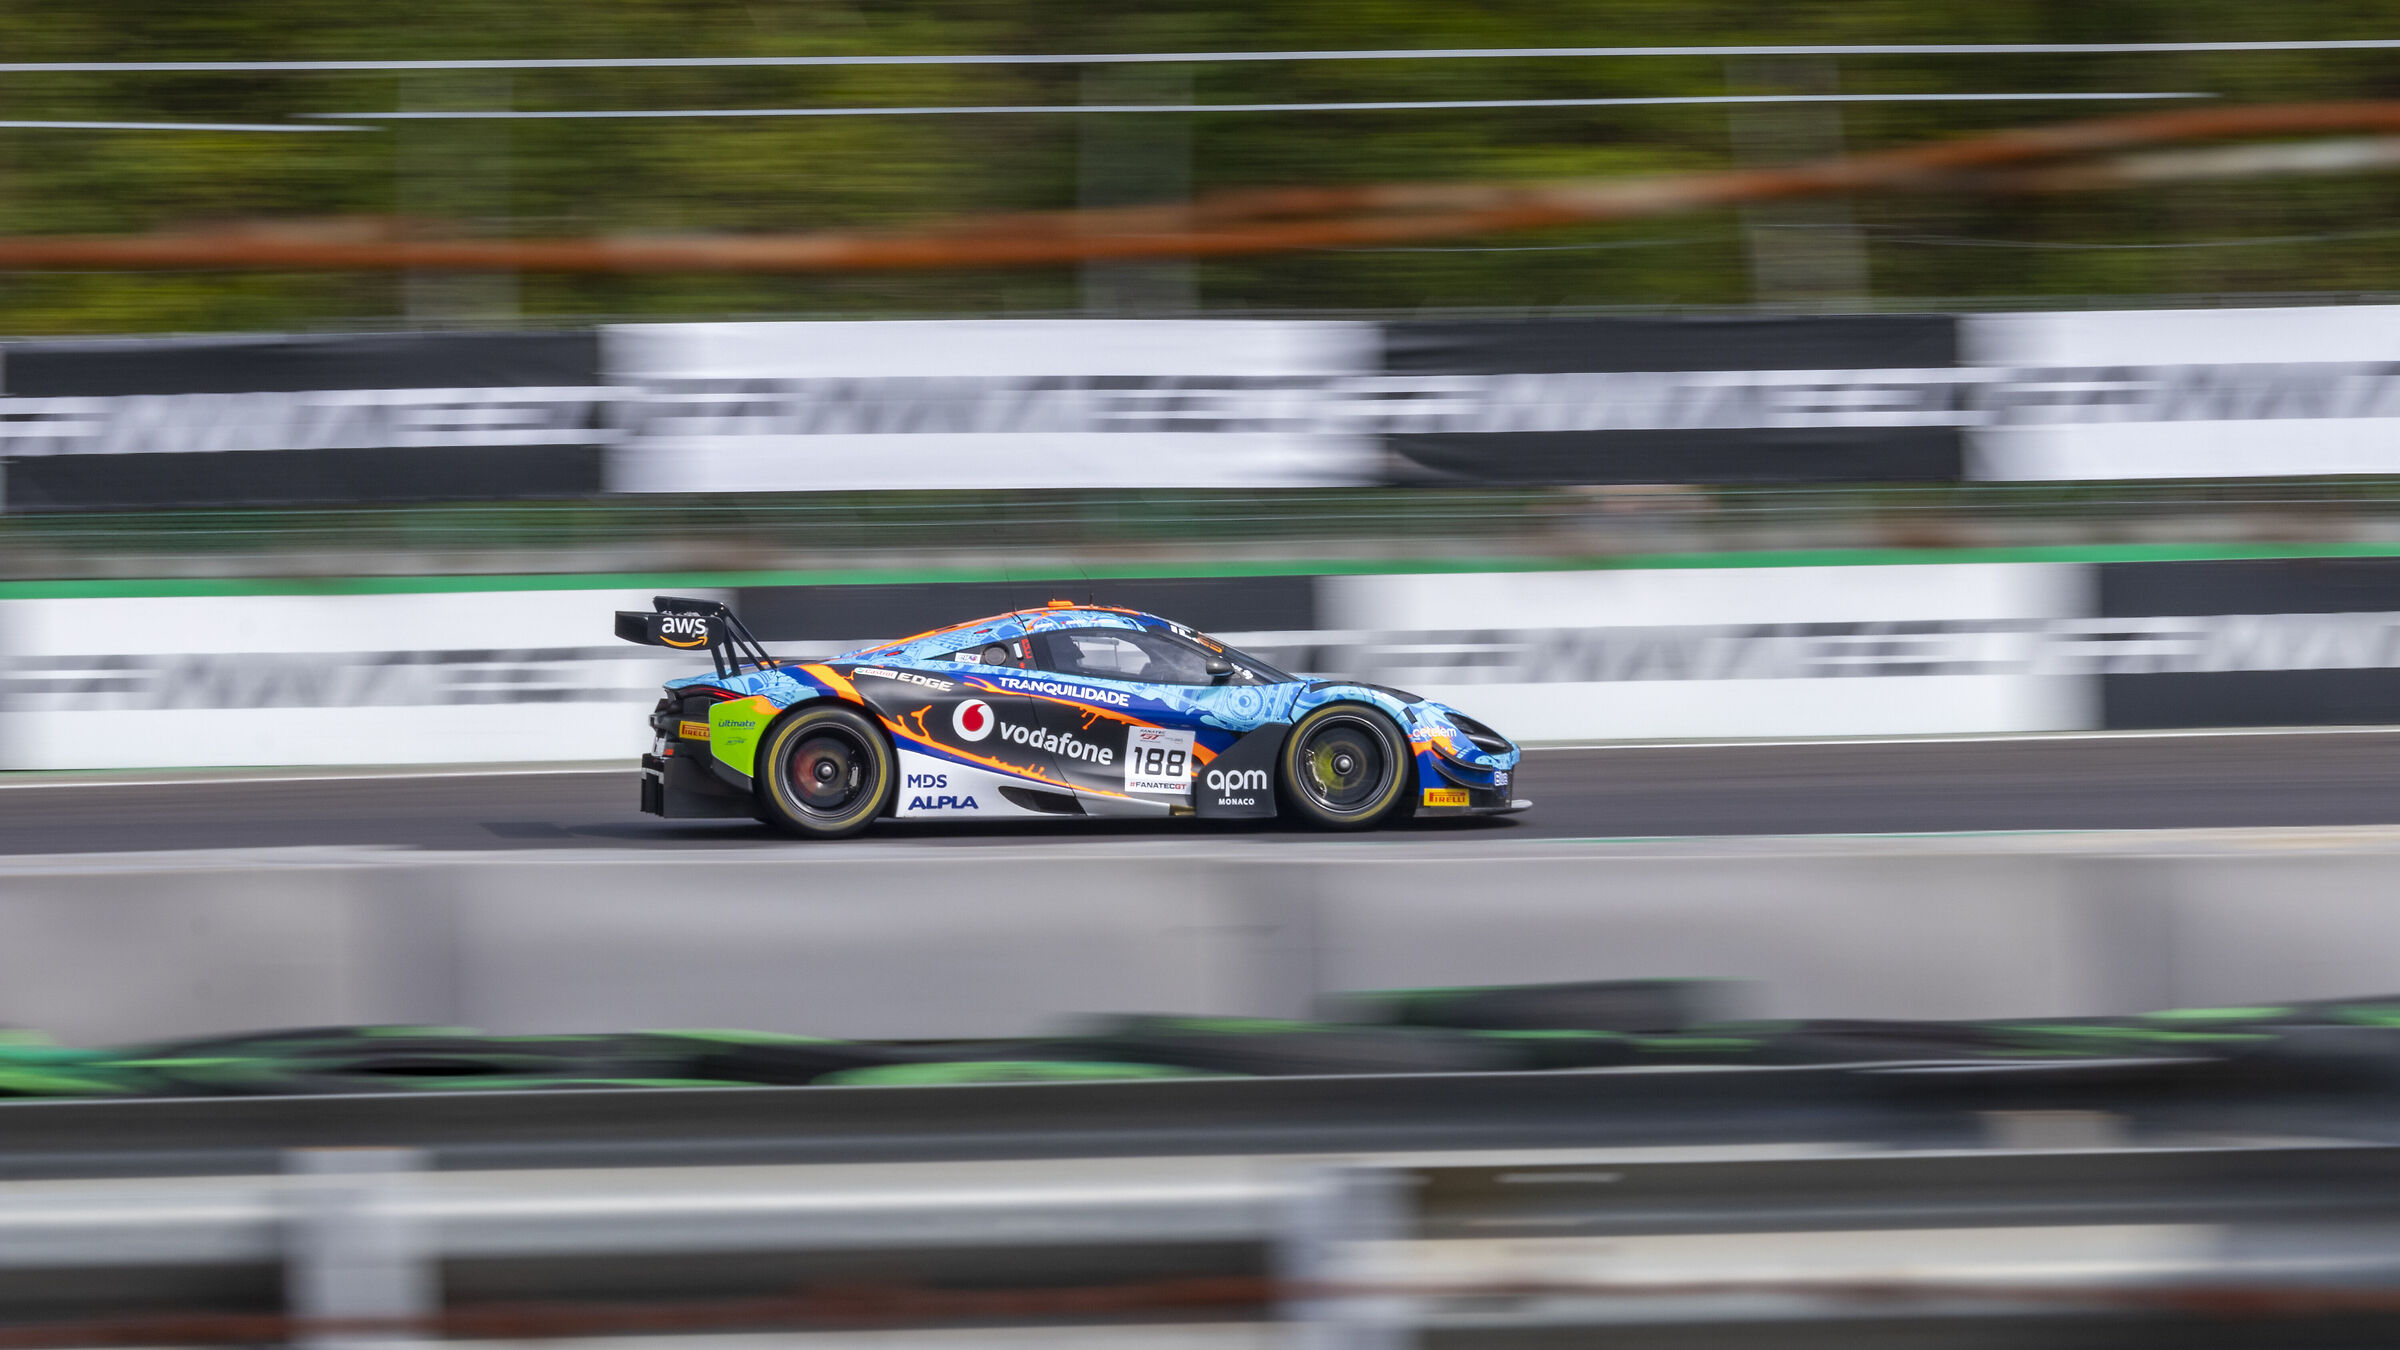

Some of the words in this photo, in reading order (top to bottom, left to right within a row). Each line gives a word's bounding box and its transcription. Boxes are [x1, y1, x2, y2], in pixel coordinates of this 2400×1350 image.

[662, 617, 706, 635] aws
[864, 668, 894, 677] Castrol
[897, 672, 955, 692] EDGE
[998, 677, 1131, 707] TRANQUILIDADE
[1412, 725, 1457, 738] cetelem
[1000, 721, 1114, 766] vodafone
[1134, 746, 1186, 777] 188
[907, 774, 948, 789] MDS
[1130, 781, 1187, 791] #FANATECGT
[1206, 769, 1267, 797] apm
[908, 795, 979, 810] ALPLA
[1218, 798, 1255, 806] MONACO
[1429, 792, 1466, 803] PIRELLI
